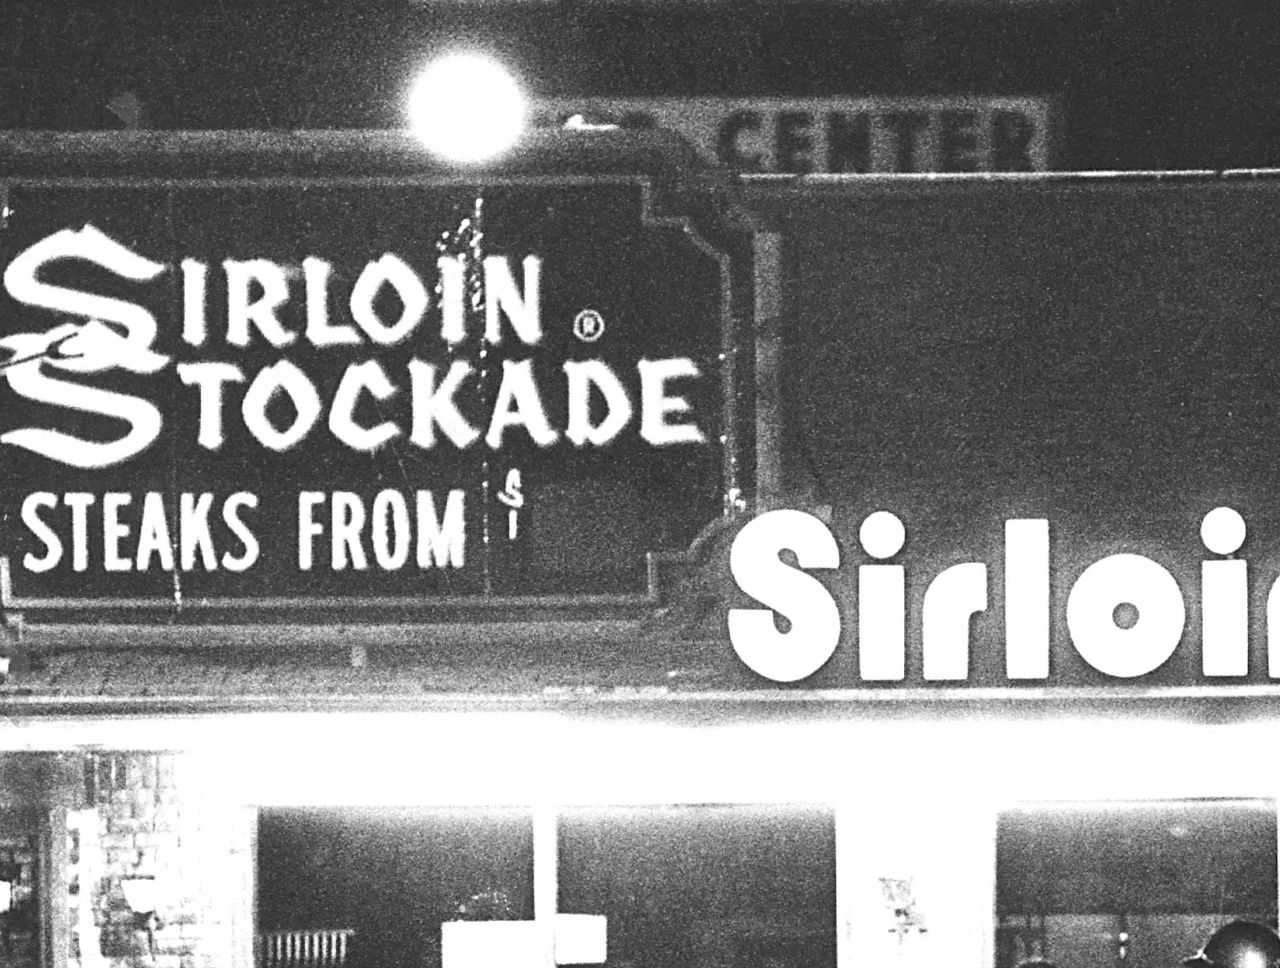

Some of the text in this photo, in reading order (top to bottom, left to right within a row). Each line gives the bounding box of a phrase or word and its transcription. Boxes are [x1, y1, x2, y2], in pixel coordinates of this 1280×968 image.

[714, 108, 1036, 174] CENTER
[3, 224, 542, 365] SIRLOIN
[0, 350, 707, 468] STOCKADE
[22, 492, 258, 572] STEAKS
[299, 490, 465, 569] FROM
